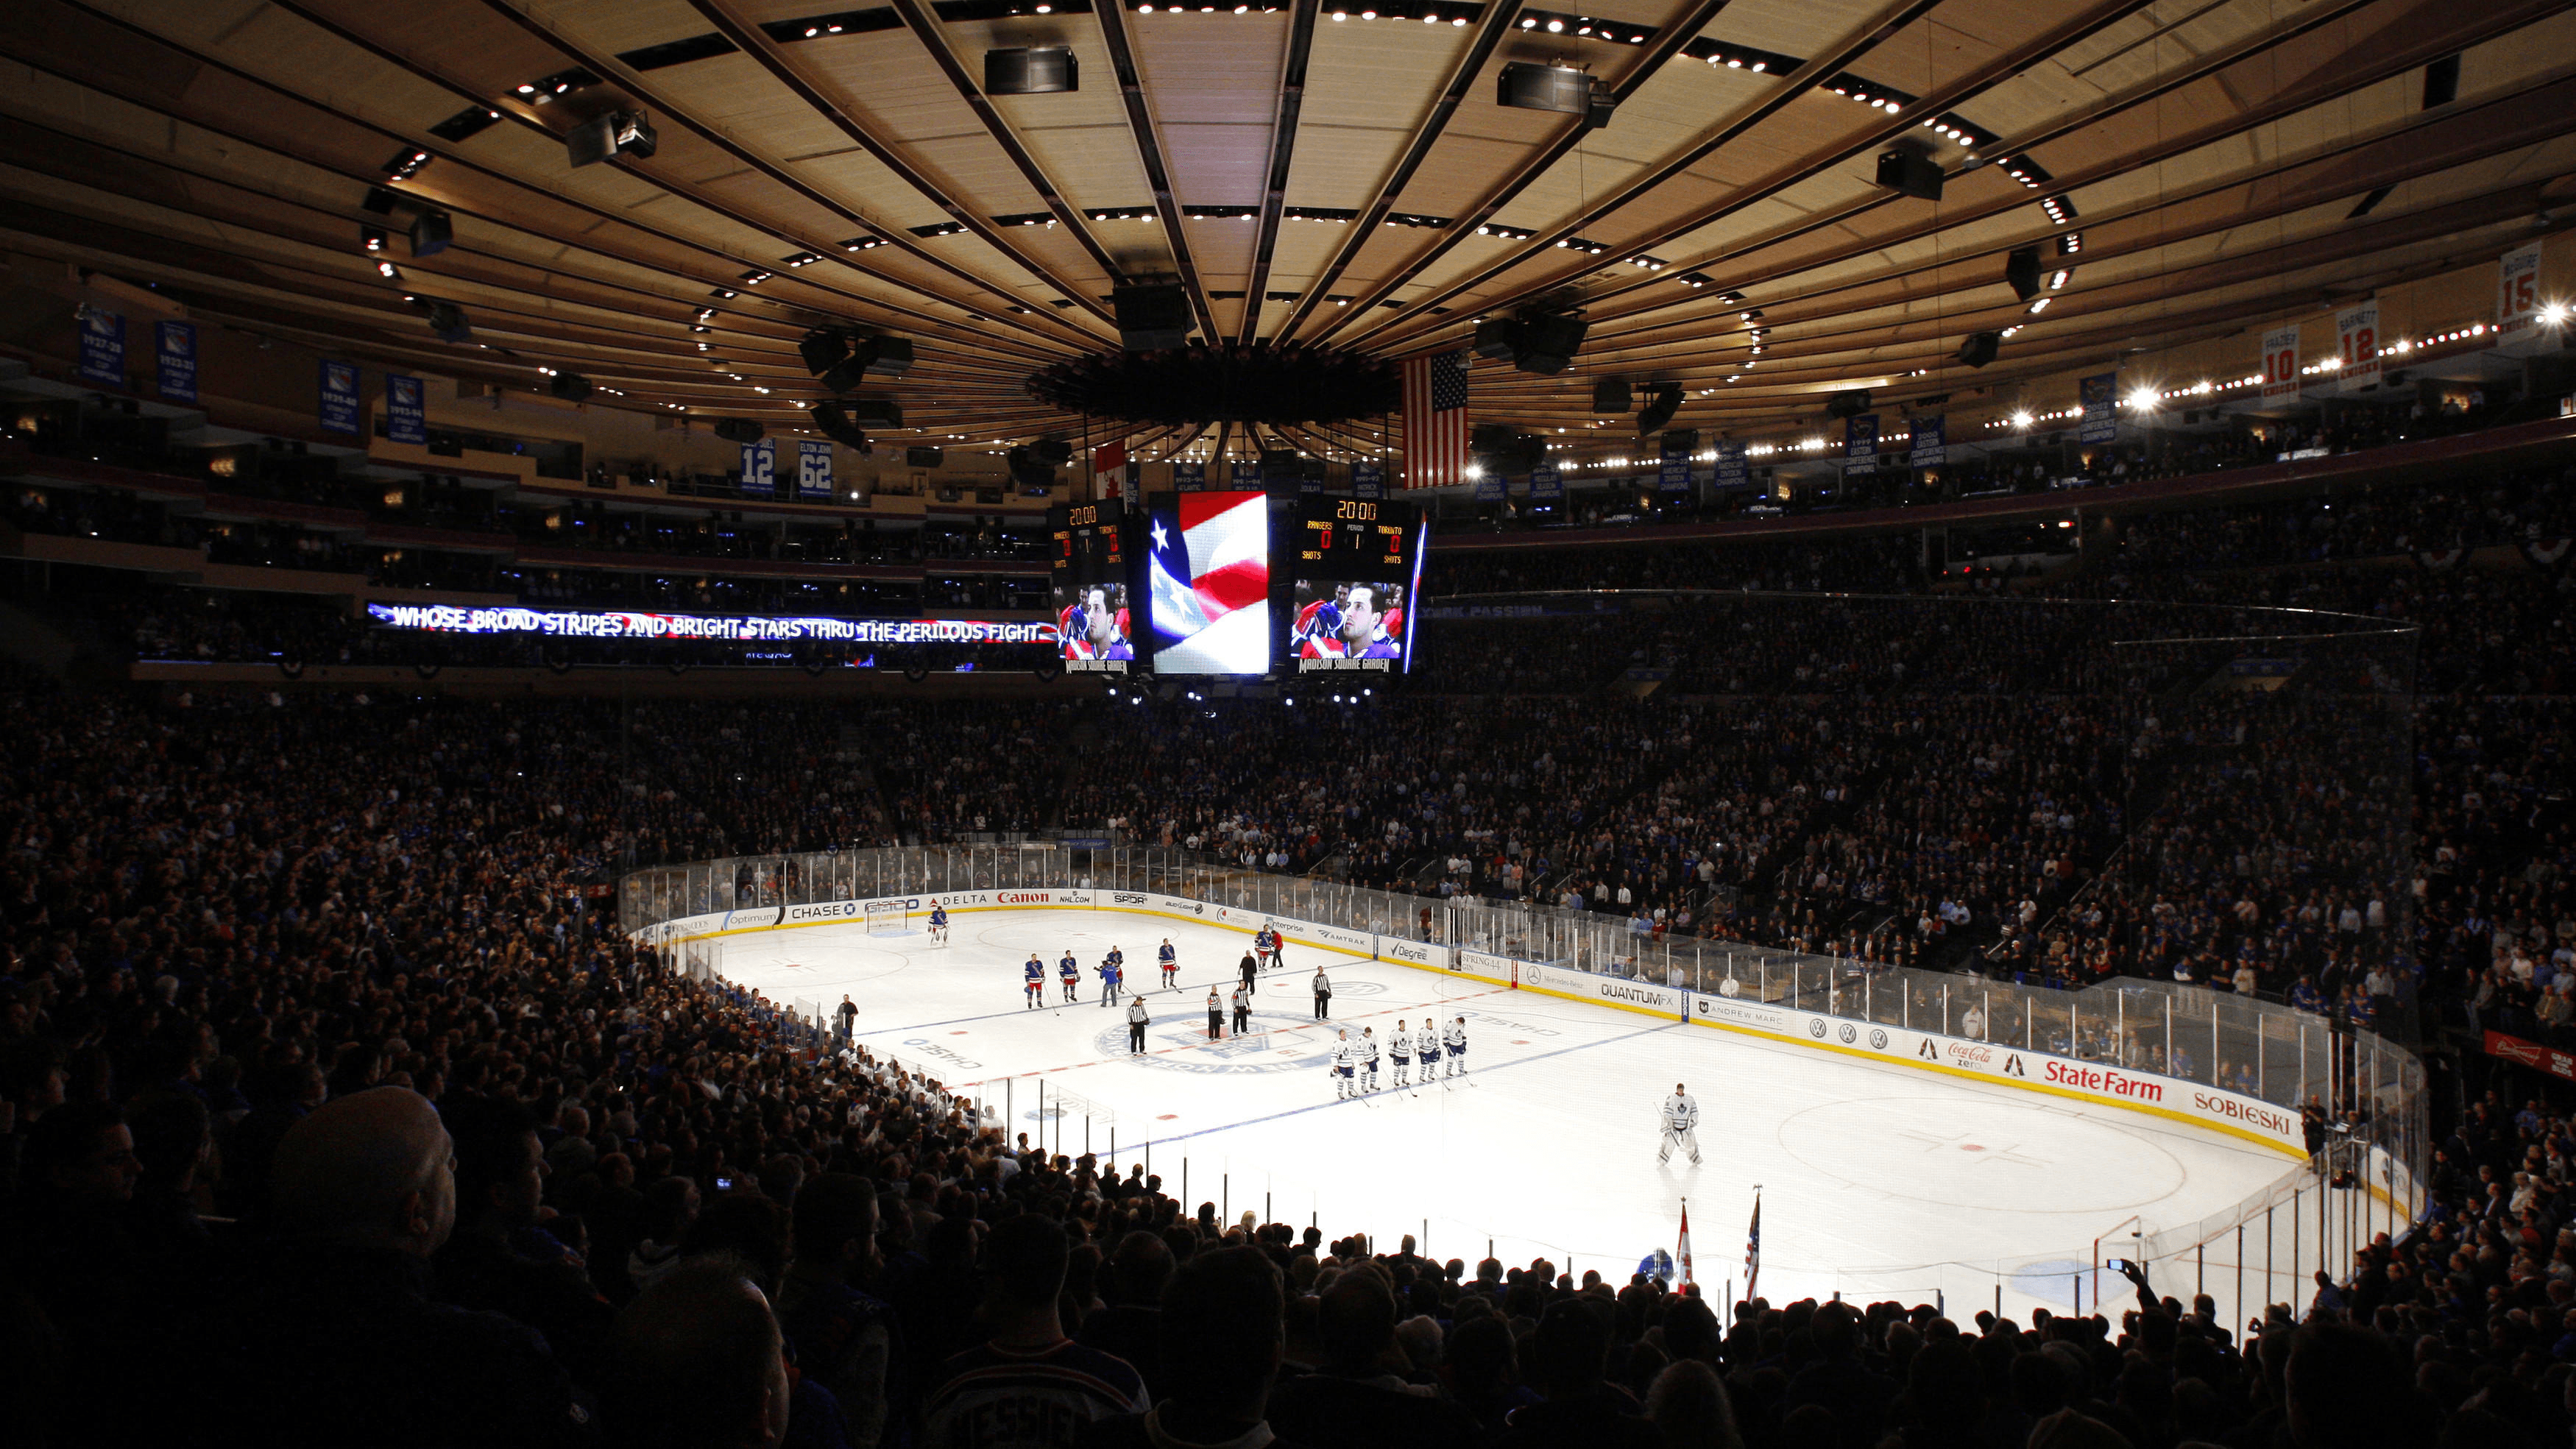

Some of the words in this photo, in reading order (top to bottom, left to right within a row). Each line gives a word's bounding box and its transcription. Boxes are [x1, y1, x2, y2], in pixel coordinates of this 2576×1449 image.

[2503, 272, 2534, 317] 15
[2343, 329, 2374, 364] 12
[2267, 350, 2293, 384] 10
[800, 443, 817, 453] ELTON
[818, 444, 832, 454] JOHN
[742, 448, 773, 485] 12
[800, 454, 831, 489] 62
[1307, 520, 1333, 531] RANGERS
[1378, 525, 1402, 535] TORONTO
[1320, 530, 1331, 549] 0
[1390, 534, 1401, 553] 0
[1302, 550, 1322, 560] SHOTS
[1384, 555, 1401, 564] SHOTS
[393, 606, 467, 628] WHOSE
[473, 610, 539, 630] BROAD
[543, 613, 623, 634] STRIPES
[628, 616, 670, 634] AND
[673, 617, 741, 636] BRIGHT
[746, 619, 802, 637] STARS
[808, 620, 854, 639] THRU
[860, 622, 894, 640] THE
[900, 623, 984, 640] PERILOUS
[988, 624, 1040, 641] FIGHT
[1299, 659, 1332, 673] MADISON
[1334, 659, 1361, 670] SQUARE
[1362, 659, 1390, 673] GARDEN
[943, 895, 987, 905] DELTA
[997, 892, 1050, 903] Canon
[1059, 896, 1090, 904] NHL.COM
[792, 904, 841, 919] CHASE
[730, 914, 776, 925] Optimum
[1330, 935, 1366, 946] AMTRAK
[1399, 946, 1428, 960] Degree
[1711, 1006, 1751, 1018] ANDREW
[1755, 1014, 1783, 1024] MARC
[1479, 1015, 1561, 1036] CHASE
[916, 1044, 984, 1070] CHASE
[1958, 1060, 1982, 1070] zero
[2194, 1093, 2290, 1136] SOBIESKI
